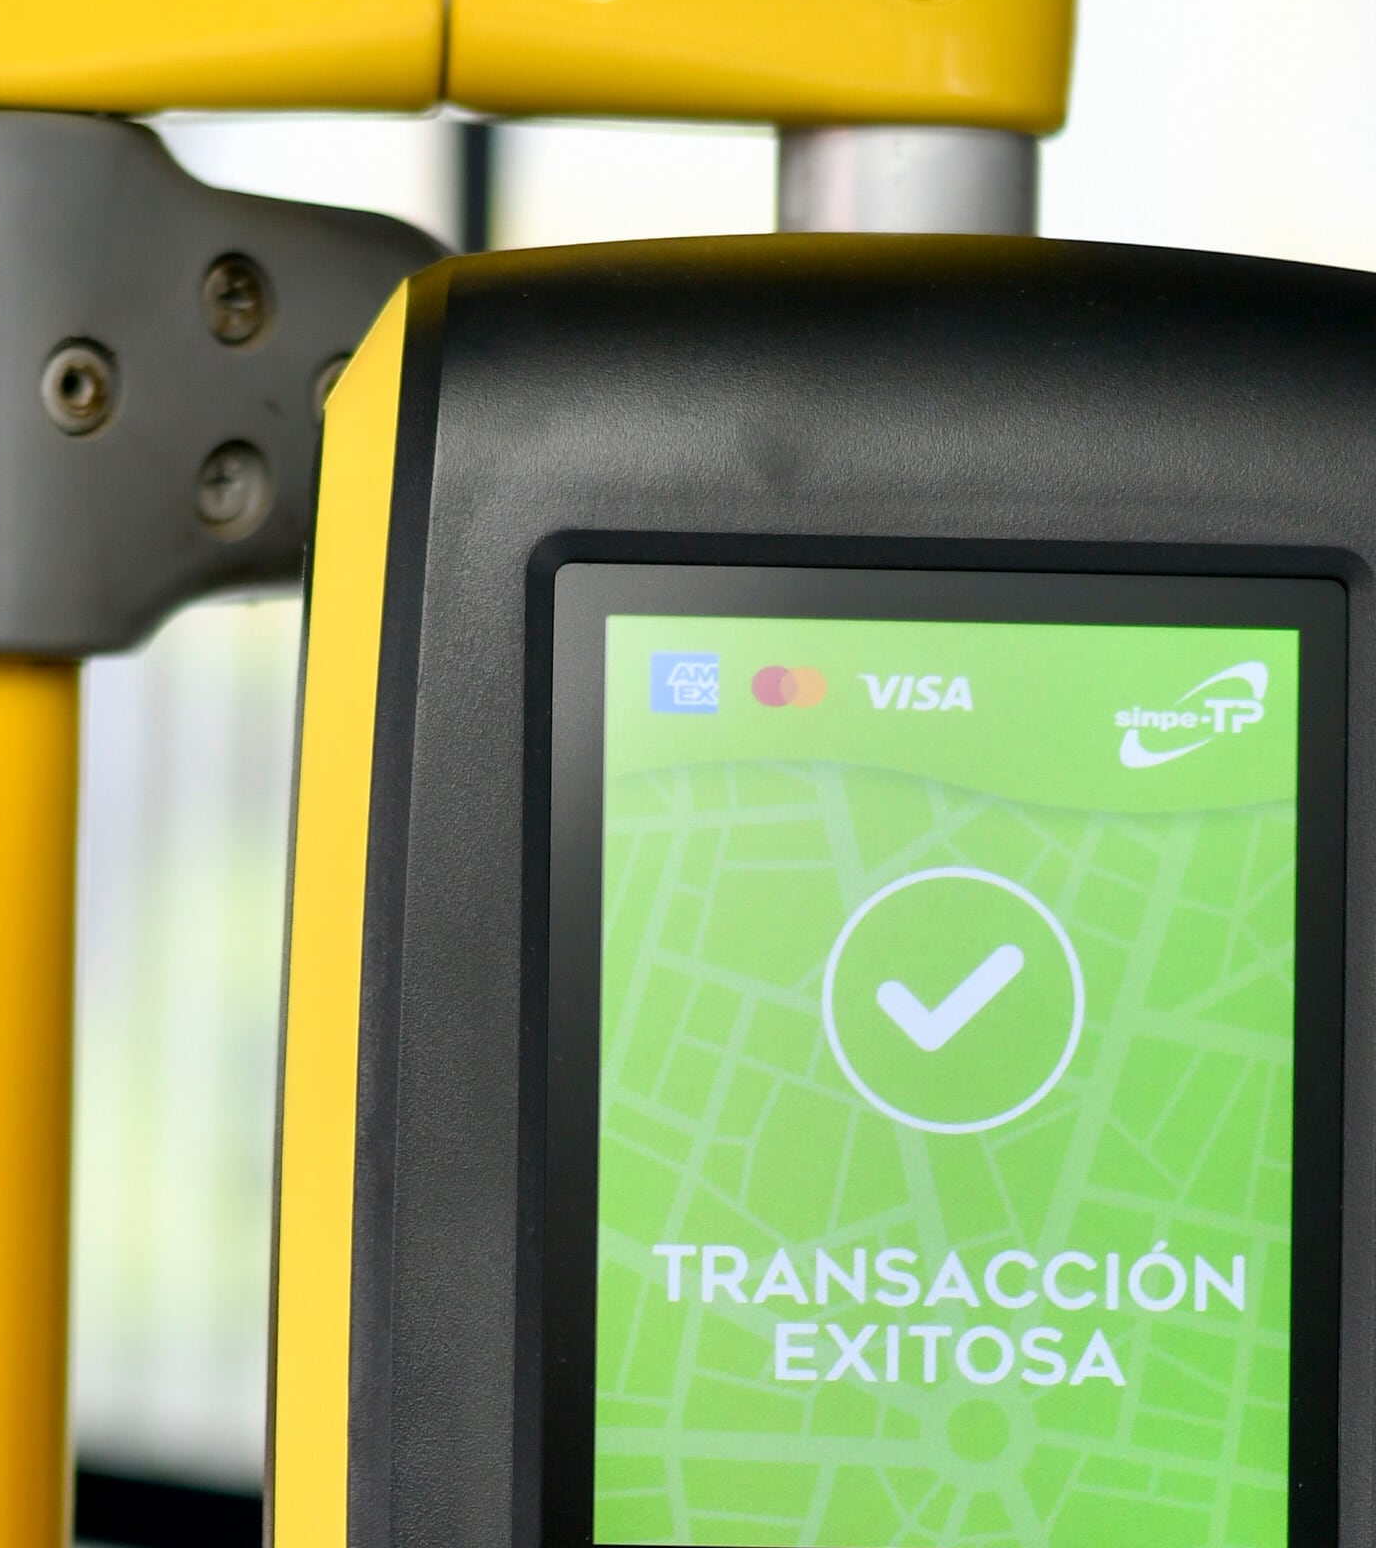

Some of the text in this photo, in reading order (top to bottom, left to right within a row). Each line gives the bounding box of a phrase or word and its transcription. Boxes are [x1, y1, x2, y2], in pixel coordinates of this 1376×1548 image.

[857, 673, 973, 712] VISA
[652, 1240, 1246, 1312] TRANSACCIÓN
[774, 1322, 1127, 1387] EXITOSA
